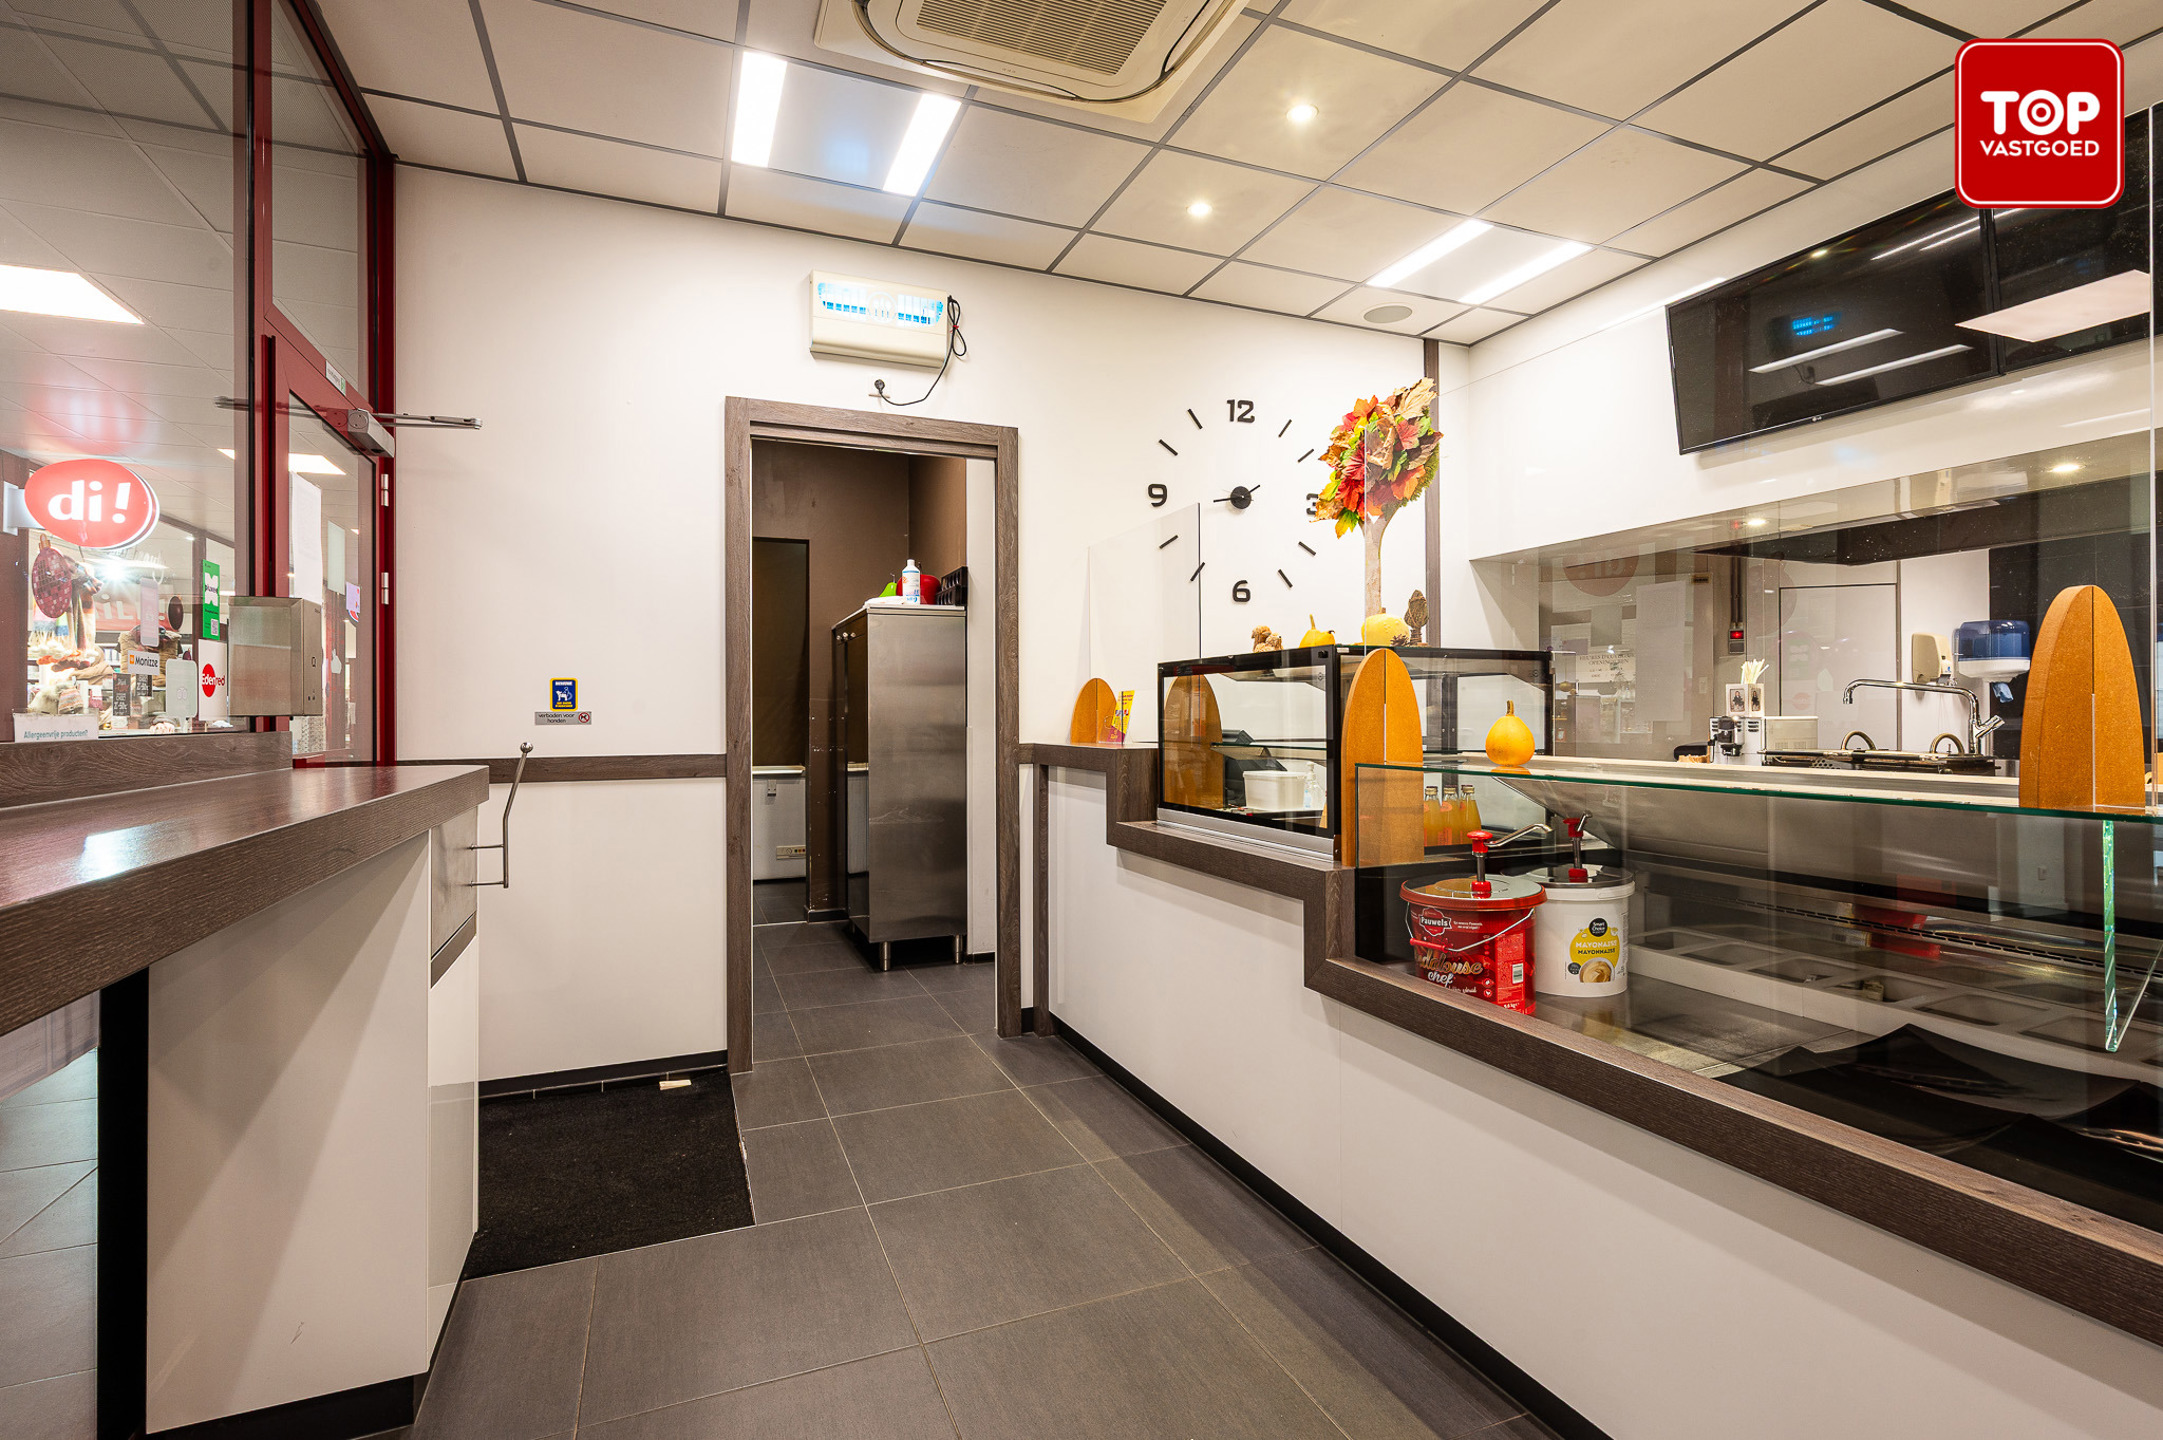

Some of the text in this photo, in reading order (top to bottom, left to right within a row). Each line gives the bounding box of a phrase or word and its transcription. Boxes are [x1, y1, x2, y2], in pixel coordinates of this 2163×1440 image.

[1226, 398, 1255, 423] 12
[47, 479, 131, 524] di!
[1147, 483, 1168, 508] 9
[1232, 579, 1251, 603] 6
[135, 656, 158, 668] Monizze
[201, 673, 225, 686] Edenred
[1420, 916, 1449, 927] Pauwels
